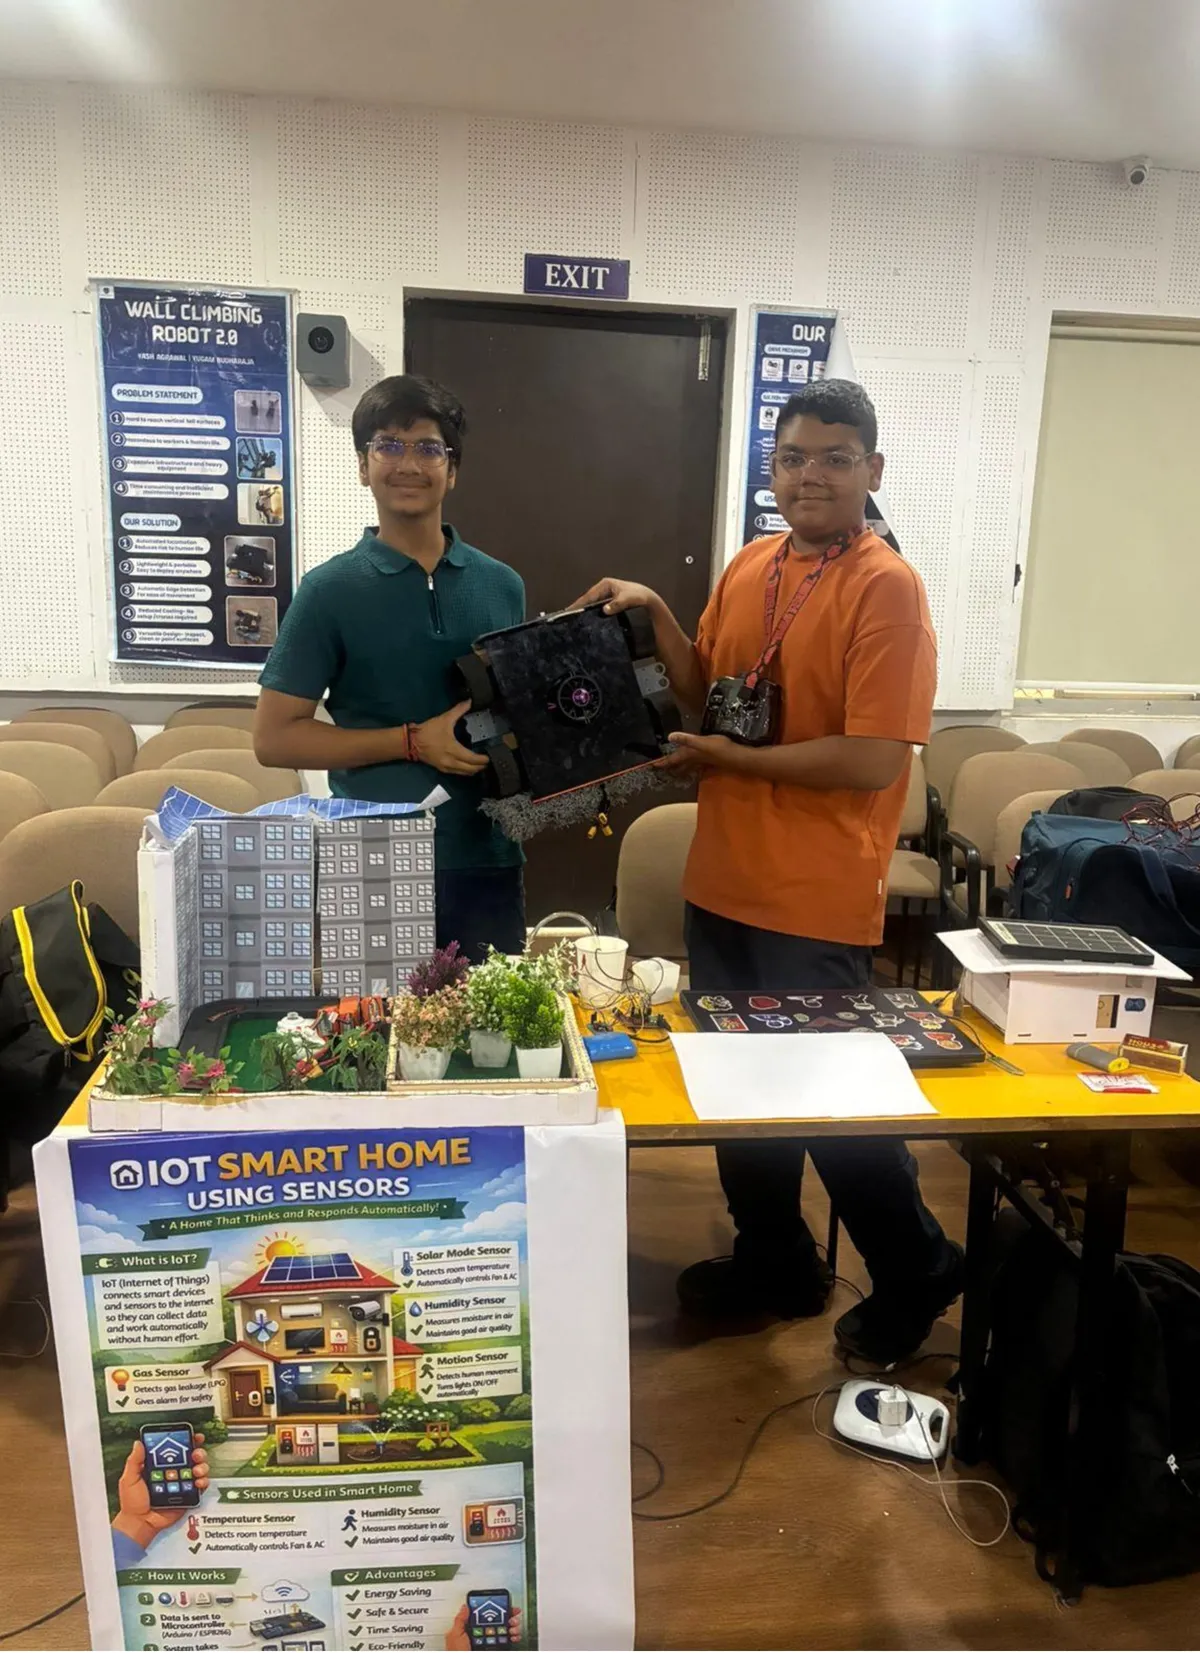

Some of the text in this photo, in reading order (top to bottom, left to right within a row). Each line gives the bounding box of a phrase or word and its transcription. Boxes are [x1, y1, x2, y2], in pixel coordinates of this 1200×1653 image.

[545, 263, 610, 290] EXIT
[124, 300, 263, 325] WALL CLIMBING
[152, 325, 239, 346] ROBOT 2.0
[792, 324, 826, 343] OUR
[117, 389, 198, 400] PROBLEM STATEMENT
[124, 518, 178, 527] OUR SOLUTION
[148, 1137, 472, 1186] IOT SMART HOME
[188, 1177, 411, 1211] USING SENSORS
[169, 1202, 440, 1230] A Home That Thinks and Responds Automatically!
[416, 1246, 512, 1261] Solar Mode Sensor
[122, 1254, 198, 1266] What is IoT?
[416, 1268, 445, 1277] Detects
[467, 1263, 510, 1274] temperature
[102, 1274, 211, 1289] IoT (Internet of Things)
[417, 1277, 465, 1288] Automatically
[465, 1274, 491, 1283] controls
[492, 1273, 503, 1281] Fan
[103, 1288, 206, 1300] connects smart devices
[104, 1298, 214, 1311] and sensors to the internet
[425, 1297, 507, 1310] Humidity Sensor
[118, 1313, 137, 1323] they
[156, 1311, 184, 1320] collect
[186, 1310, 208, 1319] data
[426, 1317, 460, 1326] Measures
[462, 1314, 494, 1323] moisture
[107, 1321, 209, 1333] and work automatically
[426, 1329, 460, 1338] Maintains
[461, 1327, 477, 1337] good
[489, 1324, 512, 1335] quality
[108, 1333, 200, 1344] without human effort.
[437, 1352, 509, 1365] Motion Sensor
[133, 1368, 191, 1378] Gas Sensor
[436, 1373, 461, 1381] Detects
[485, 1367, 519, 1376] movement
[134, 1385, 163, 1393] Detects
[164, 1386, 177, 1394] gas
[178, 1382, 207, 1392] leakage
[455, 1381, 472, 1389] lights
[156, 1396, 178, 1404] alarm
[179, 1395, 190, 1404] for
[191, 1394, 213, 1403] safety
[436, 1389, 480, 1398] automatically
[243, 1484, 414, 1499] Sensors Used in Smart Home
[361, 1506, 441, 1518] Humidity Sensor
[201, 1514, 296, 1525] Temperature Sensor
[362, 1521, 449, 1533] Measures moisture in air
[205, 1530, 235, 1539] Detects
[259, 1529, 308, 1539] temperature
[362, 1533, 455, 1545] Maintains good air quality
[205, 1543, 258, 1553] Automatically
[259, 1542, 289, 1551] controls
[290, 1542, 306, 1550] Fan
[148, 1571, 226, 1580] How It Works
[365, 1569, 437, 1580] Advantages
[364, 1587, 432, 1599] Energy Saving
[160, 1614, 181, 1622] Data
[366, 1608, 387, 1618] Safe
[398, 1607, 429, 1615] Secure
[161, 1621, 226, 1630] Microcontroller
[366, 1624, 424, 1635] Time Saving
[162, 1630, 193, 1640] (Arduino
[197, 1643, 219, 1651] takes
[368, 1640, 425, 1651] Eco-Friendly
